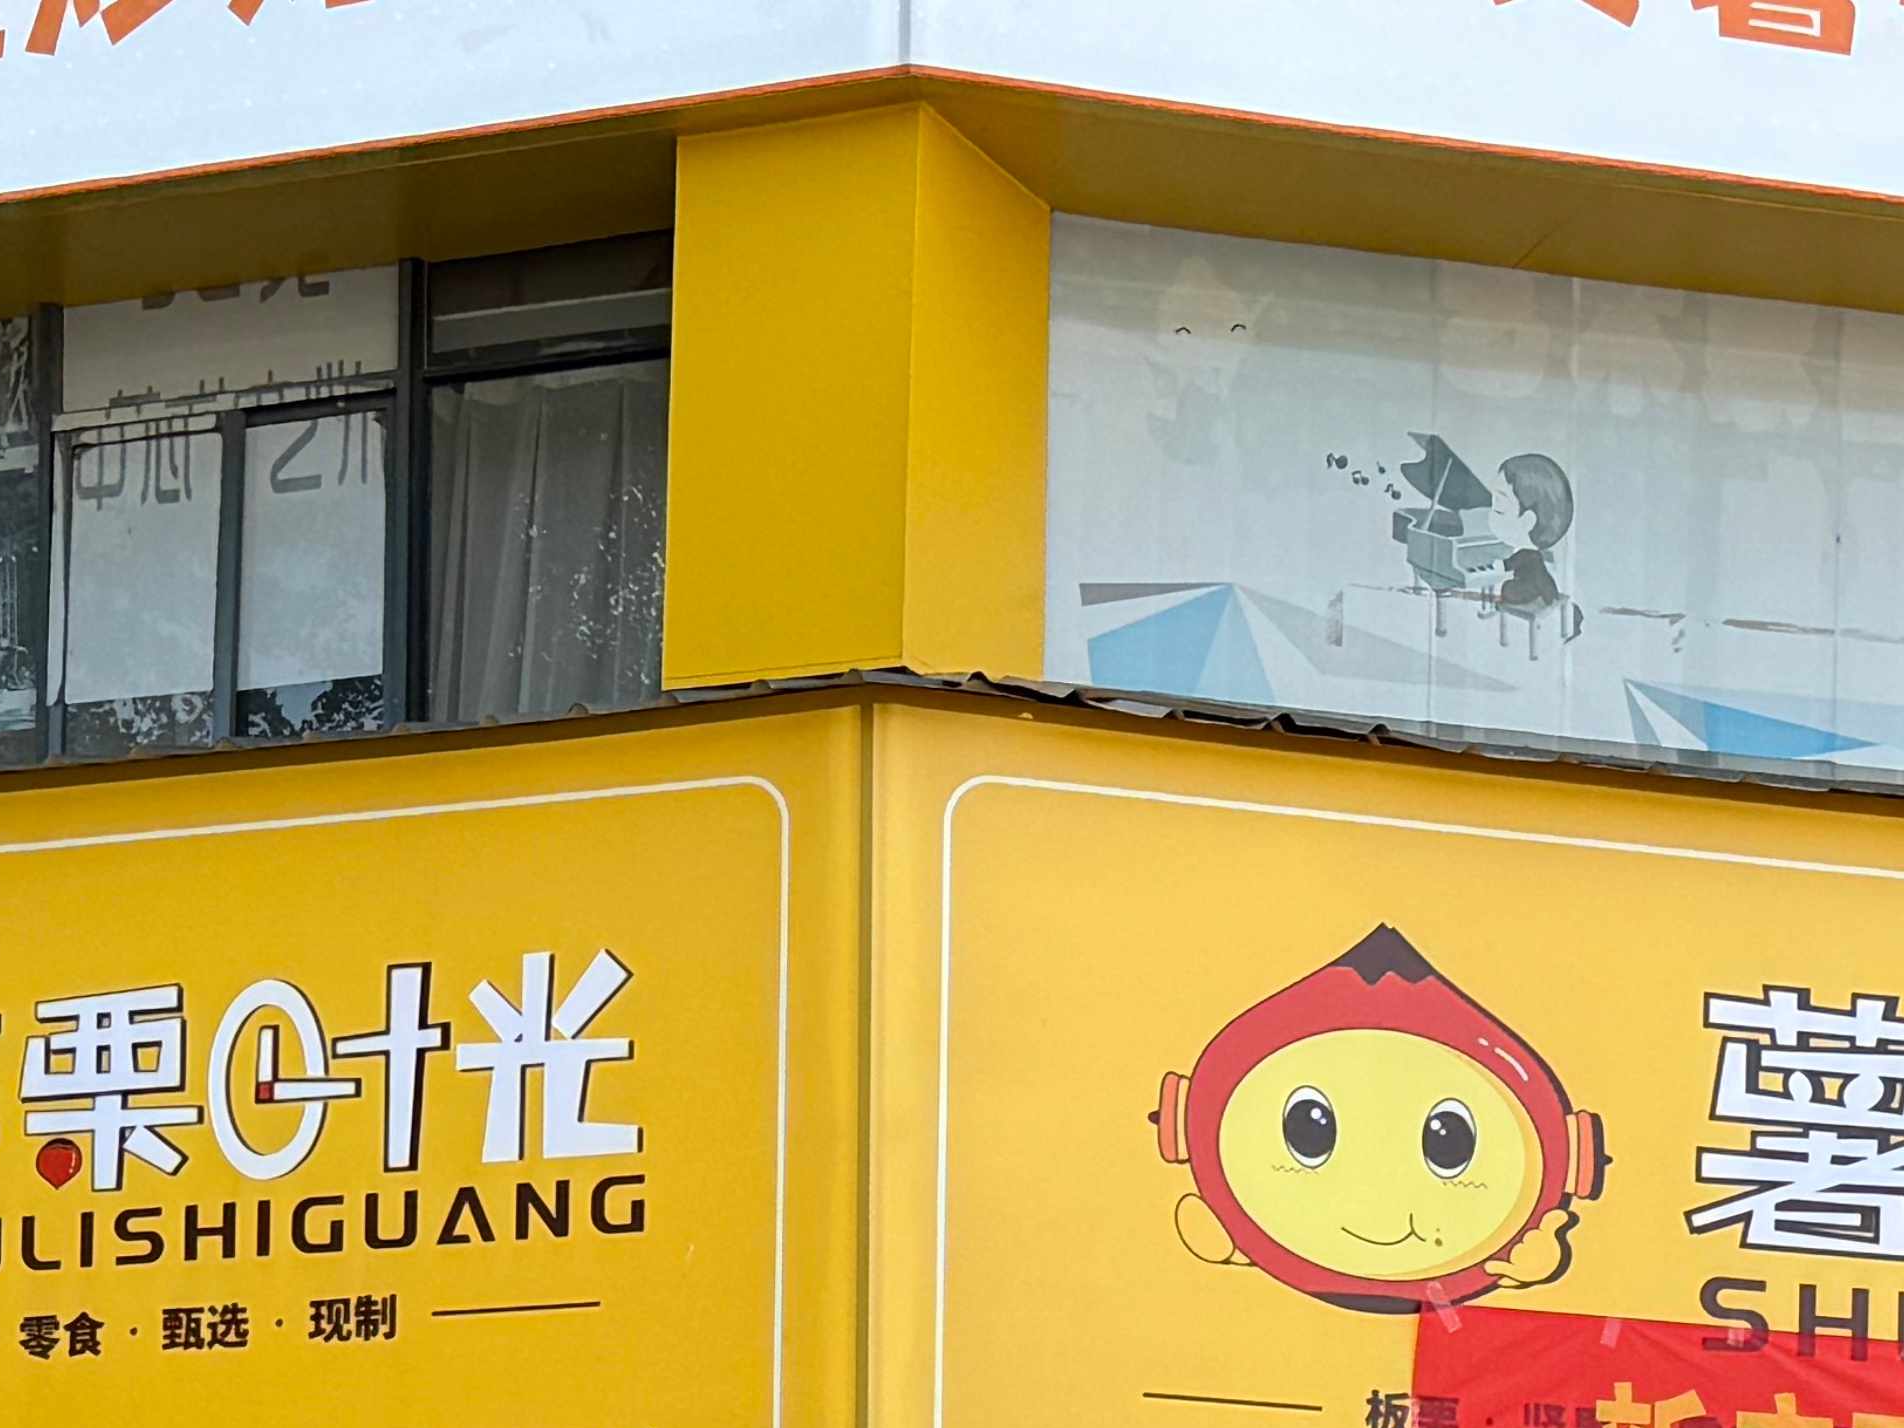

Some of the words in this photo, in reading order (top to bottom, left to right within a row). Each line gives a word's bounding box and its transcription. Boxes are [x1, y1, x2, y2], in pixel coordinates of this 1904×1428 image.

[18, 1311, 105, 1362] 零食
[161, 1302, 250, 1354] 甄选
[307, 1294, 399, 1345] 现制
